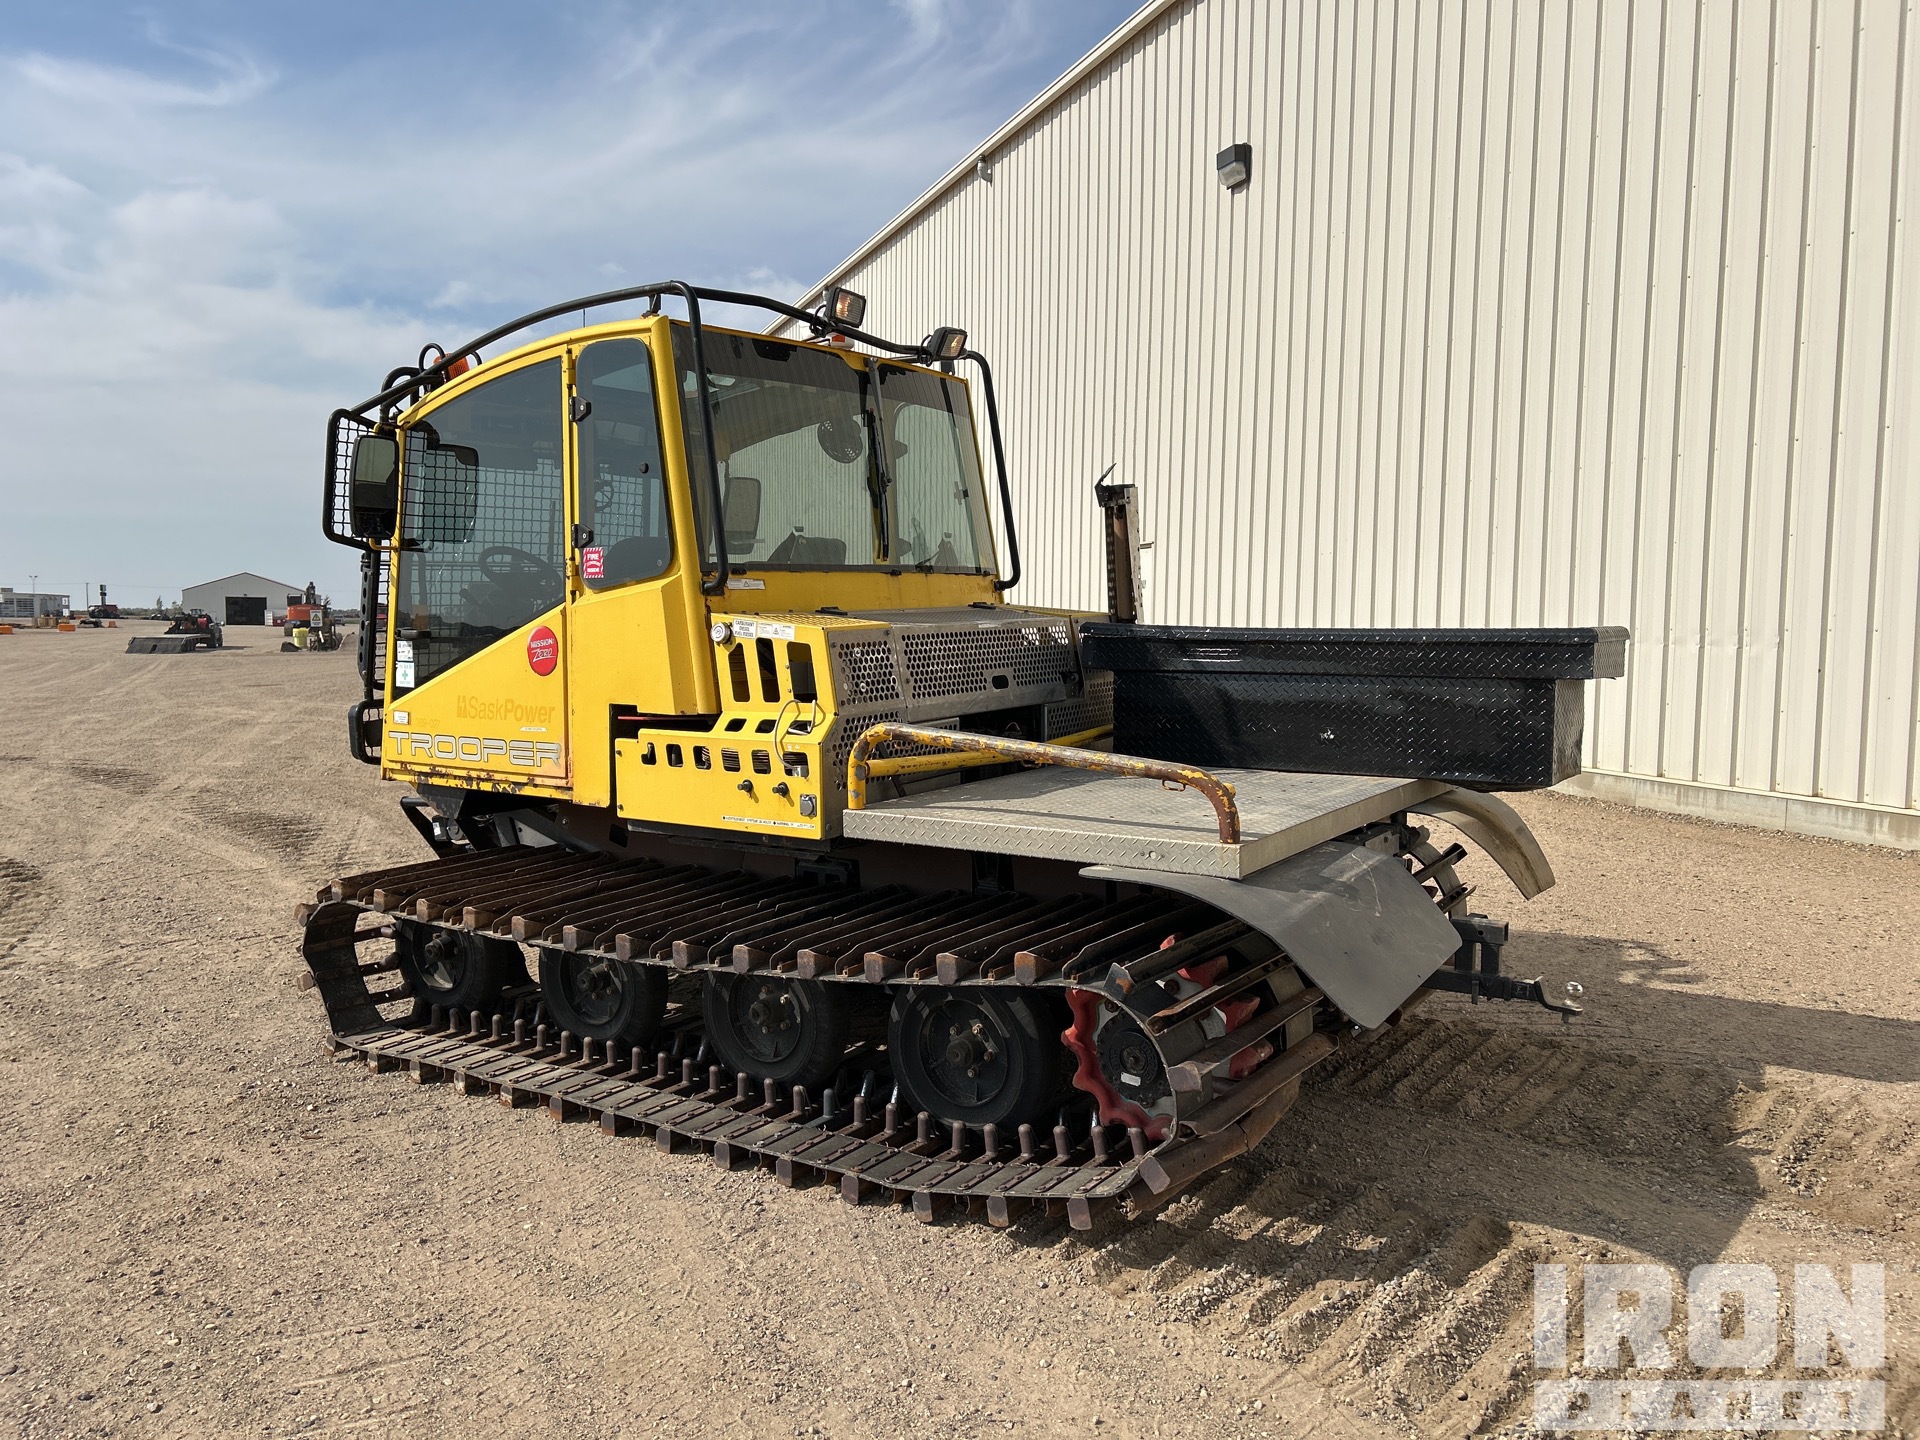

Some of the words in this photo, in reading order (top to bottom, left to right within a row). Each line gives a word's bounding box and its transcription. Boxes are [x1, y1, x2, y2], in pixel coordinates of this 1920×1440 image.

[587, 553, 599, 561] FIRE
[530, 637, 555, 649] MISSION:
[468, 696, 555, 724] SaskPower
[388, 730, 561, 767] TROOPER
